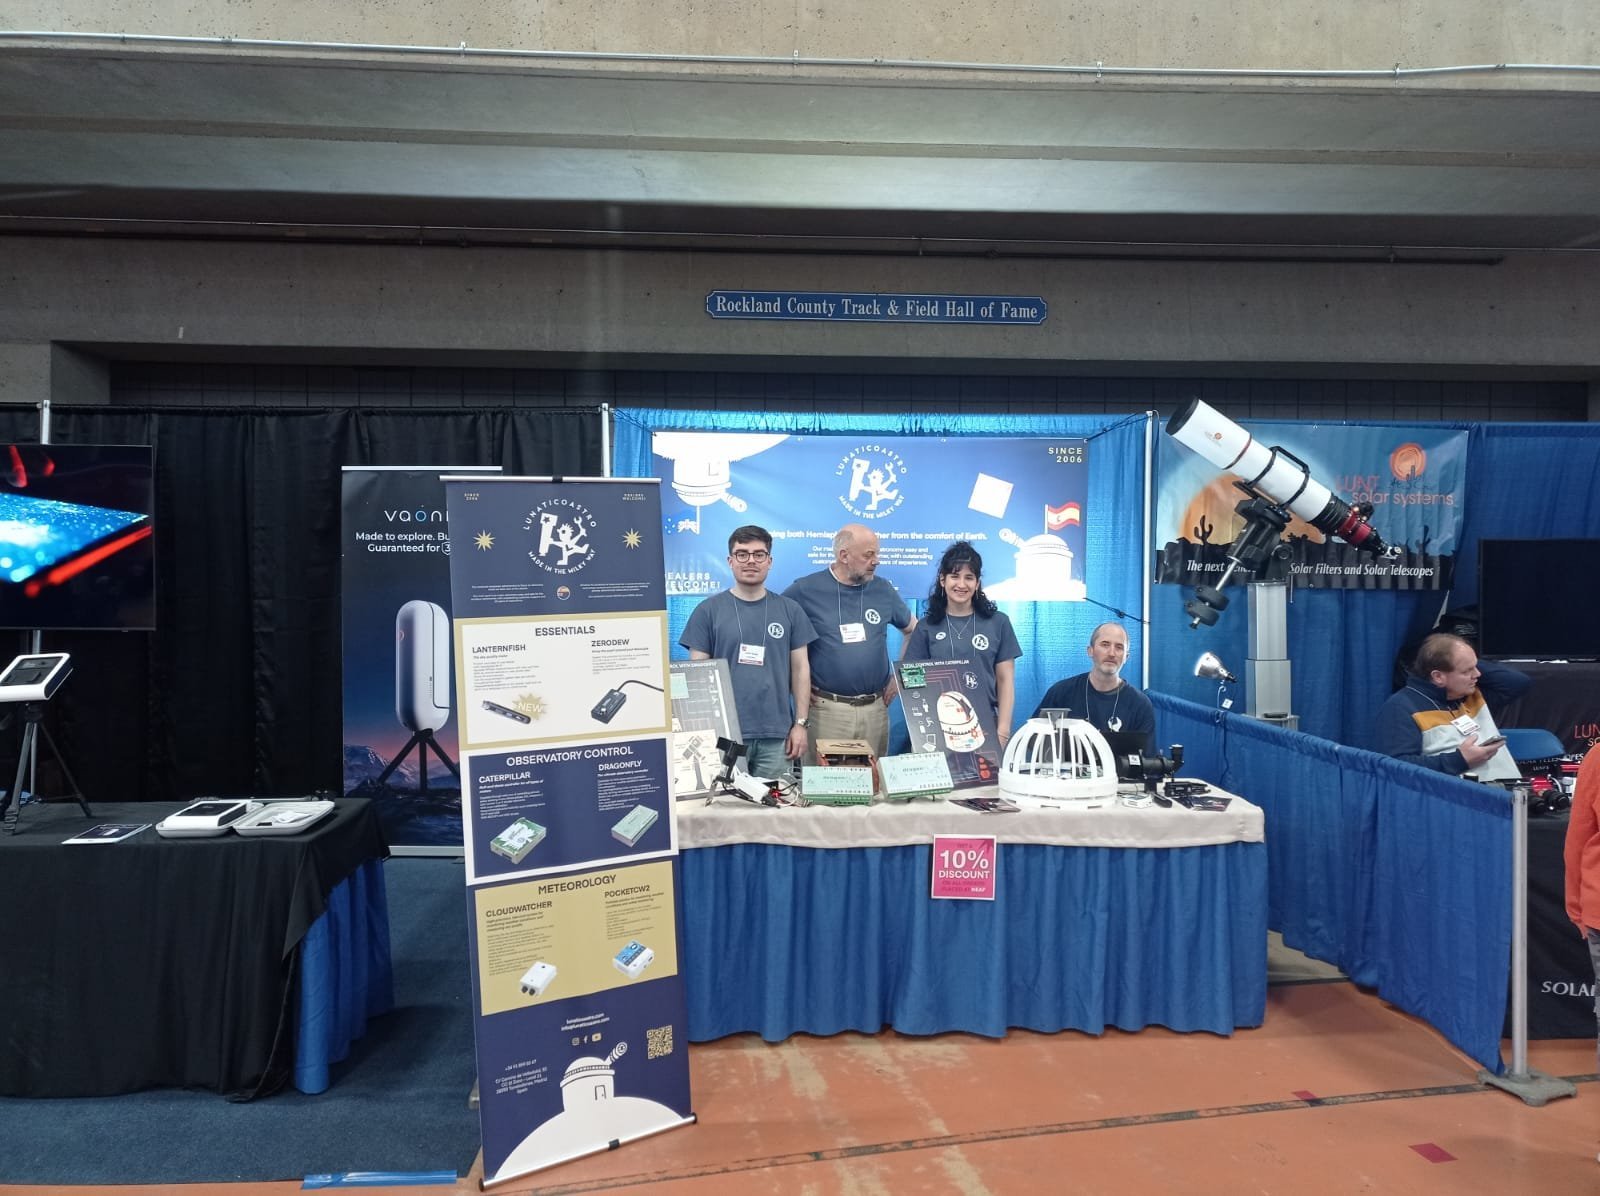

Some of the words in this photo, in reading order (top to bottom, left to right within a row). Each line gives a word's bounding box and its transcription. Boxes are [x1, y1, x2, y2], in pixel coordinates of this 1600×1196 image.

[716, 295, 781, 313] Rockland
[787, 297, 836, 317] County
[842, 298, 881, 315] Track
[887, 300, 899, 316] &
[906, 300, 939, 317] Field
[946, 301, 974, 317] Hall
[980, 302, 994, 318] of
[1001, 302, 1038, 318] Fame
[1048, 447, 1083, 455] SINCE
[835, 445, 907, 476] LUNATICOASTRO
[1056, 455, 1083, 463] 2006
[1335, 475, 1379, 492] LUNT
[1351, 490, 1390, 504] solar
[1393, 491, 1454, 508] systems
[523, 499, 597, 530] LUNATICOASTRO
[355, 532, 383, 541] Made
[385, 533, 395, 541] to
[397, 532, 435, 542] explore.
[891, 531, 909, 539] from
[910, 531, 922, 539] the
[924, 531, 954, 539] comfort
[955, 531, 964, 539] of
[965, 532, 988, 540] Earth.
[367, 543, 424, 552] Guaranteed
[426, 543, 440, 552] for
[528, 551, 544, 567] MADE
[568, 561, 586, 574] MILKY
[1187, 559, 1202, 572] The
[1204, 561, 1225, 572] next
[1290, 562, 1313, 574] Solar
[1314, 562, 1342, 575] Filters
[1344, 564, 1362, 575] and
[1364, 564, 1388, 576] Solar
[1390, 564, 1434, 578] Telescopes
[664, 572, 711, 580] EALERS
[535, 625, 596, 637] ESSENTIALS
[472, 644, 526, 654] LANTERNFISH
[591, 639, 630, 647] ZERODEW
[518, 701, 544, 714] NEW
[506, 750, 583, 767] OBSERVATORY
[584, 746, 634, 760] CONTROL
[598, 760, 642, 771] DRAGONFLY
[479, 771, 531, 784] CATERPILLAR
[940, 849, 989, 869] 10%
[938, 870, 990, 879] DISCOUNT
[538, 874, 617, 895] METEOROLOGY
[604, 884, 650, 898] POCKETCW2
[486, 900, 553, 918] CLOUDWATCHER
